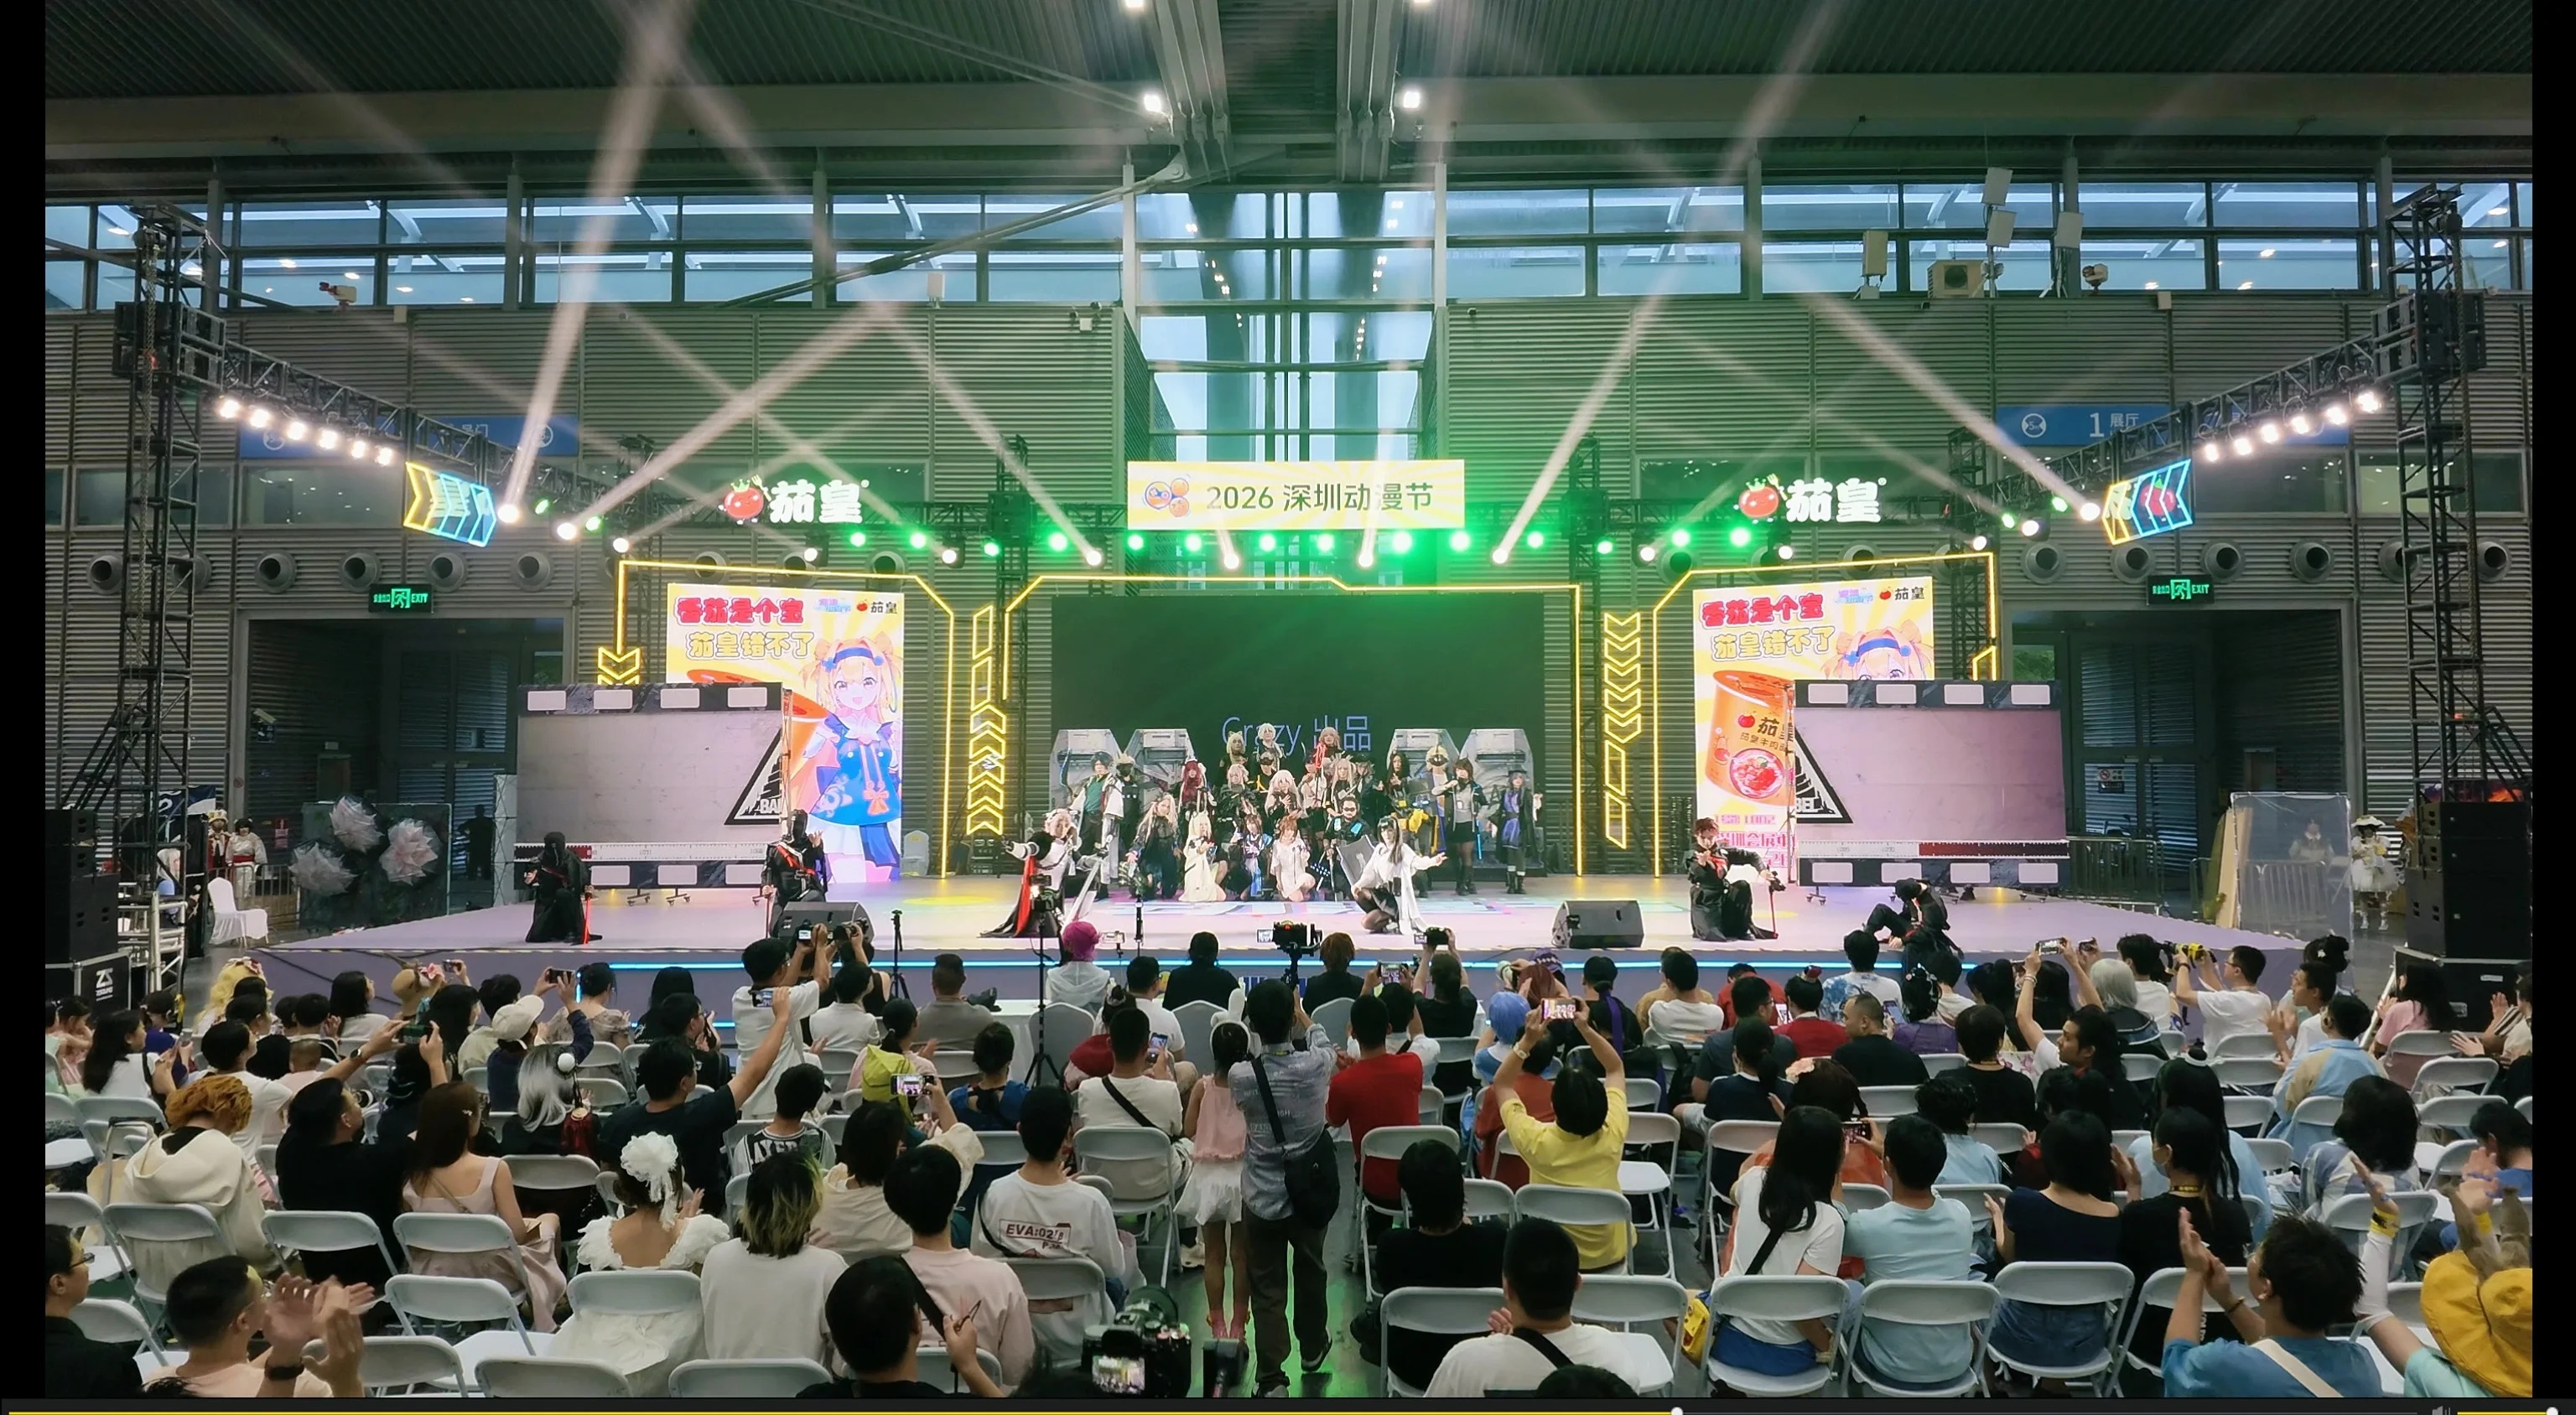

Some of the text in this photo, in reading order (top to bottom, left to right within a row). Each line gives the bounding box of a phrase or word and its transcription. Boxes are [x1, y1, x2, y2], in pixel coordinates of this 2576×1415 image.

[770, 479, 863, 523] 茄皇
[1206, 483, 1433, 511] 2026 深圳动漫节
[1785, 477, 1881, 522] 茄皇
[411, 593, 428, 603] EXIT
[2191, 584, 2210, 593] EXIT
[675, 597, 805, 625] 番茄是个宝
[1701, 592, 1825, 627] 番茄是个宝
[688, 631, 815, 659] 茄皇错不了
[1712, 626, 1836, 660] 茄皇错不了
